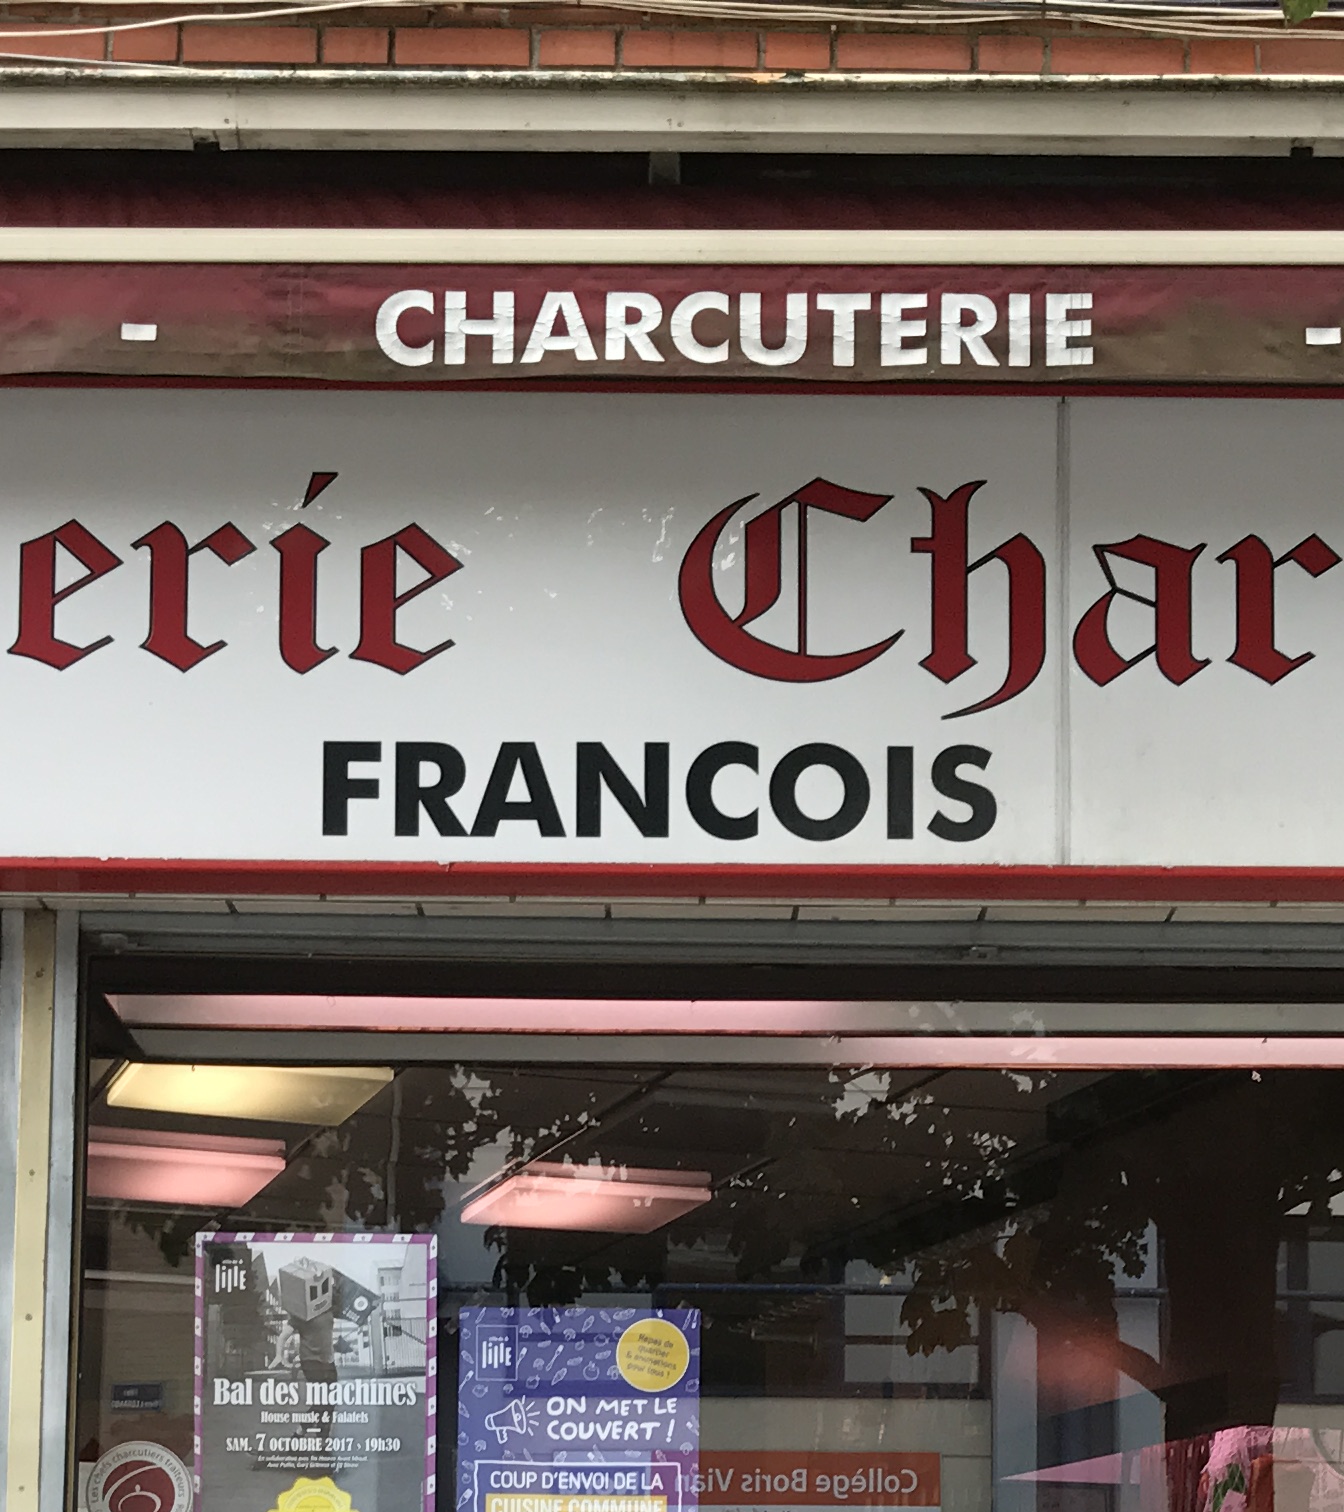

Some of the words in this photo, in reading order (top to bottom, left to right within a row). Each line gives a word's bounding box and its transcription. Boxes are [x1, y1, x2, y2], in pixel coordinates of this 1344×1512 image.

[374, 288, 1095, 369] CHARCUTERIE
[321, 740, 997, 842] FRANCOIS
[213, 1377, 253, 1405] Bal
[259, 1377, 299, 1405] des
[306, 1377, 417, 1406] machines
[260, 1411, 290, 1423] House
[292, 1410, 320, 1424] music
[321, 1411, 330, 1423] &
[546, 1396, 586, 1416] ON
[595, 1399, 648, 1416] MET
[654, 1397, 678, 1415] LE
[546, 1419, 662, 1441] COUVERT
[225, 1437, 253, 1452] SAM.
[256, 1433, 267, 1452] 7
[269, 1437, 322, 1452] OCTOBRE
[324, 1437, 353, 1452] 2017
[365, 1437, 401, 1452] 19h30
[112, 1448, 164, 1465] charcutiers
[164, 1458, 185, 1498] traiteurs
[490, 1471, 537, 1489] COUP
[614, 1472, 638, 1490] DE
[641, 1472, 664, 1490] LA
